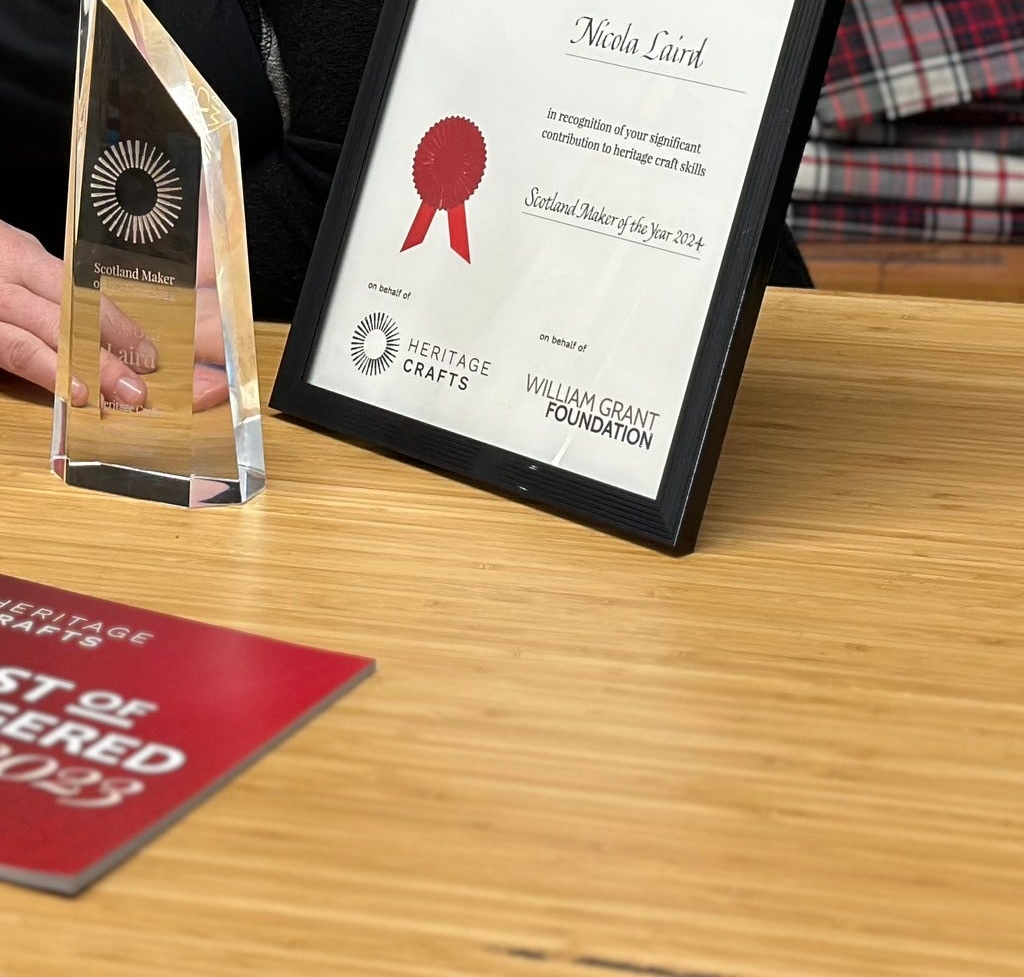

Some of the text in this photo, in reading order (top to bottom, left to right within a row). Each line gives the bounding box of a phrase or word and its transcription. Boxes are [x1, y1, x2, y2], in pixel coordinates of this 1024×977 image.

[570, 16, 708, 69] Nicola Laird
[541, 128, 706, 177] contribution to heritage craft skills
[547, 107, 702, 155] in recognition of your significant
[524, 187, 704, 251] Scotland Maker of the Year 2024
[94, 262, 175, 285] Scotland Maker
[368, 281, 411, 301] on behalf of
[408, 338, 492, 377] HERITAGE
[539, 333, 587, 353] on behalf of
[403, 359, 469, 391] CRAFTS
[526, 373, 660, 431] WILLIAM GRANT
[545, 402, 654, 450] FOUNDATION
[78, 690, 159, 718] OF
